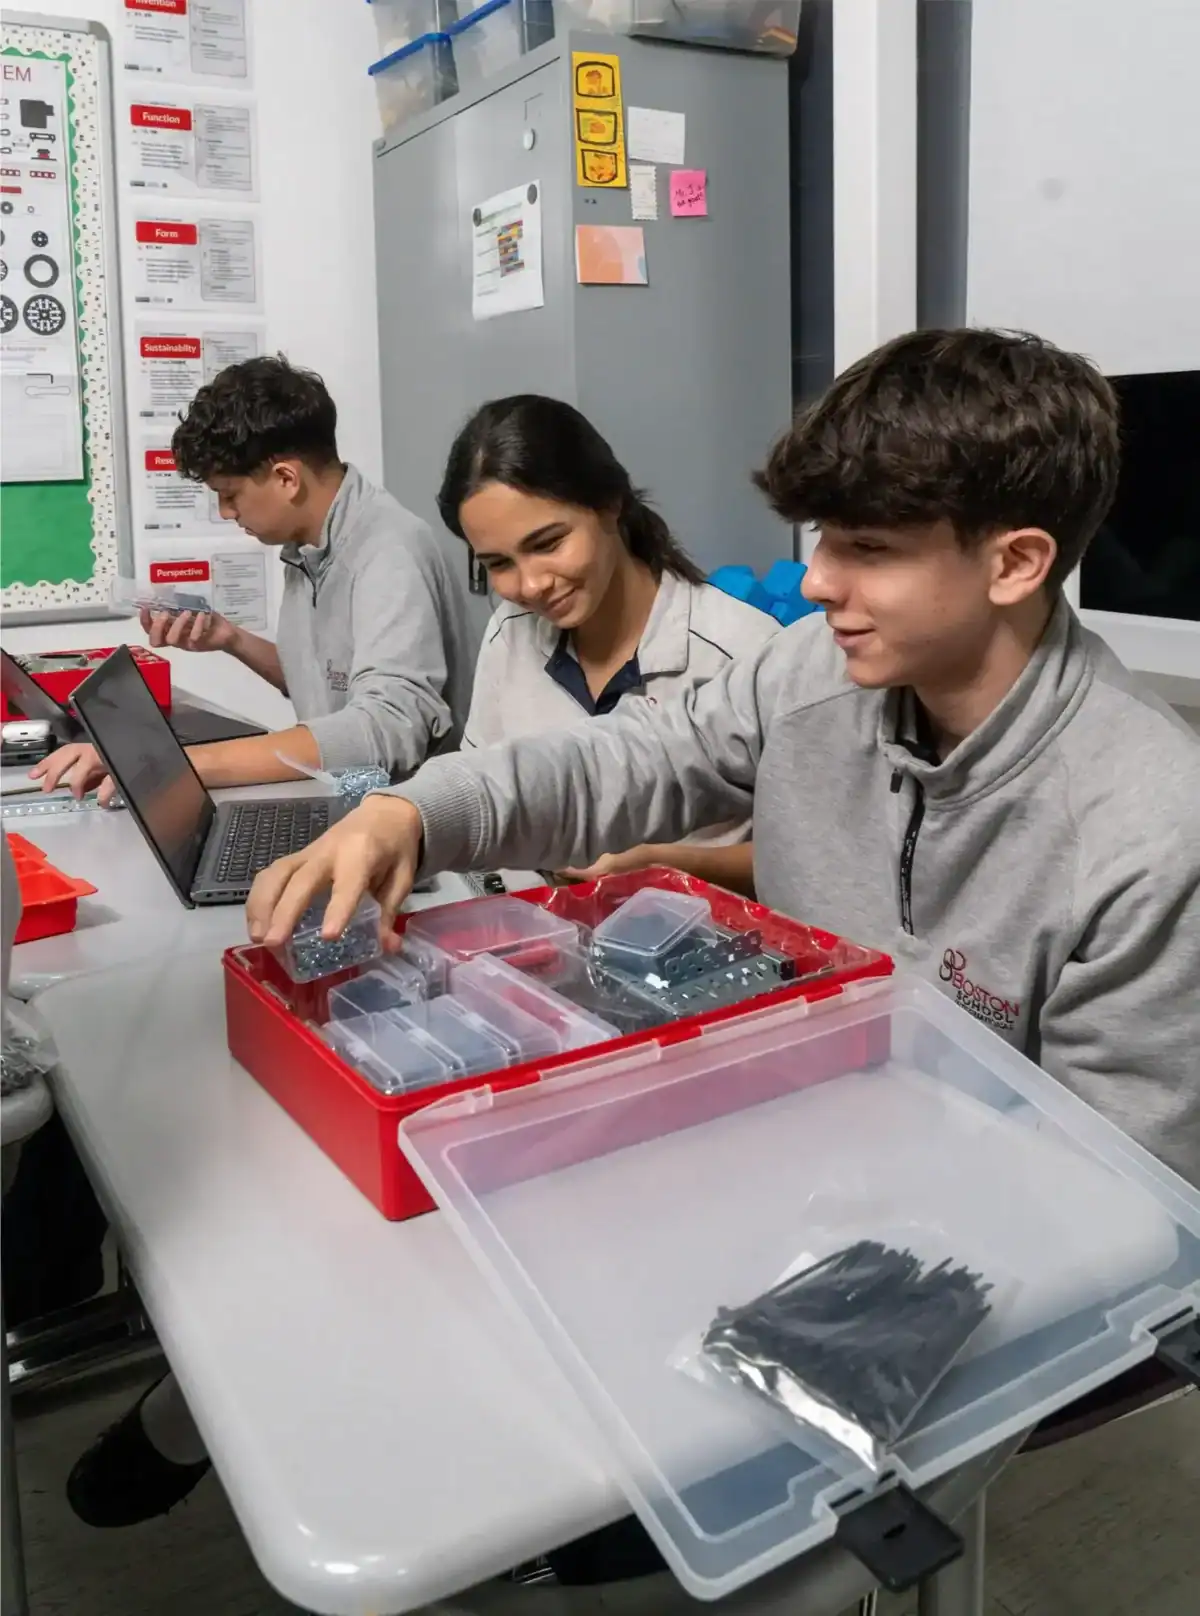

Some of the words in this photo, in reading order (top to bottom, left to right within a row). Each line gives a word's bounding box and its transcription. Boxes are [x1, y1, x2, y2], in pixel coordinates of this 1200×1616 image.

[0, 64, 31, 82] EM
[142, 111, 180, 125] Function
[155, 228, 178, 238] Form
[156, 567, 204, 578] Perspective
[952, 971, 1019, 1017] BOSTON
[955, 990, 1015, 1024] SCHOOL
